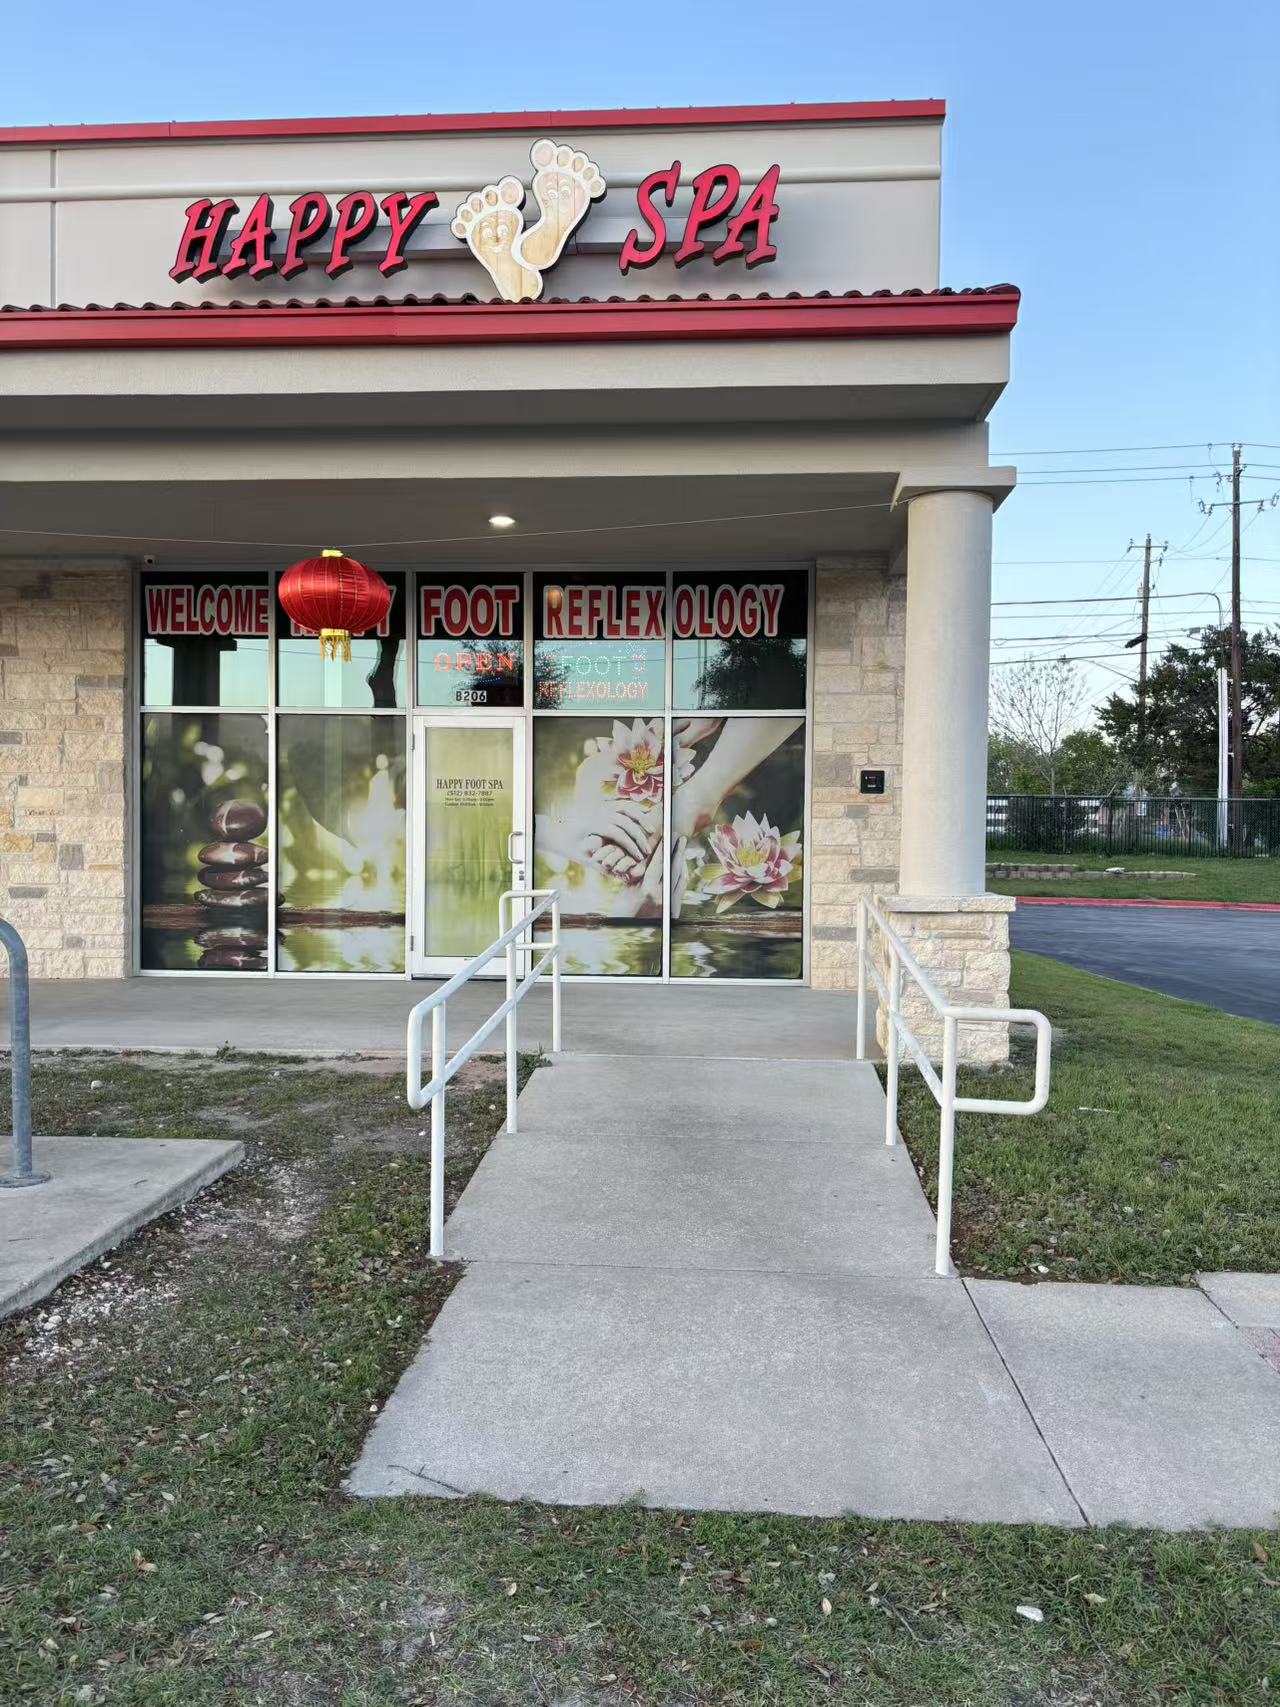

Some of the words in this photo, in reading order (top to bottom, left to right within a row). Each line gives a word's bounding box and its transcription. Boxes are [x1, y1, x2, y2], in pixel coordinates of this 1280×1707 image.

[168, 191, 440, 284] HAPPY
[619, 160, 781, 276] SPA
[145, 584, 269, 636] WELCOME
[420, 584, 520, 636] FOOT
[543, 584, 785, 638] REFLEXOLOGY
[434, 652, 515, 672] OPEN
[561, 655, 627, 675] FOOT
[539, 682, 648, 699] REFLEXOLOGY
[436, 779, 463, 789] HAPPY
[465, 779, 487, 789] FOOT
[488, 779, 504, 789] SPA
